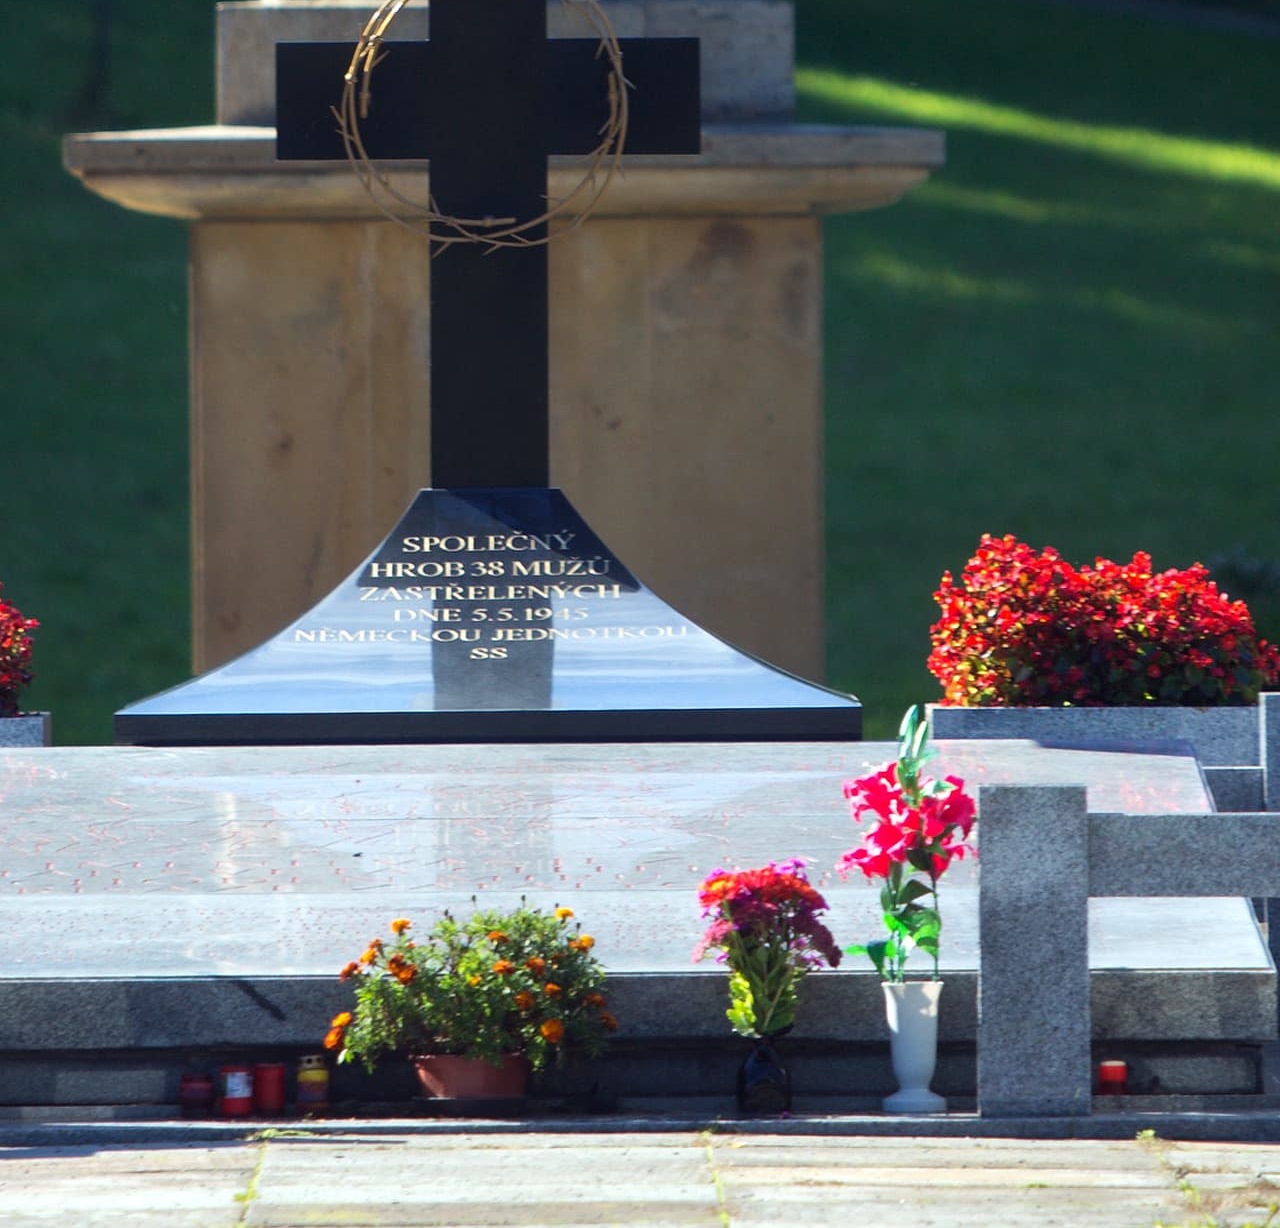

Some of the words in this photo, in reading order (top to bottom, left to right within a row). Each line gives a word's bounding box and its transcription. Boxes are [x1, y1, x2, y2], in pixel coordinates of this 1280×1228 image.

[402, 530, 576, 553] SPOLEČNÝ
[371, 561, 465, 578] HROB
[471, 560, 505, 577] 38
[512, 557, 610, 576] MUŽŮ
[360, 581, 620, 601] ZASTŘELENÝCH
[394, 608, 462, 622] DNE
[295, 627, 481, 643] NĚMECKOU
[491, 626, 687, 641] JEDNOTKOU
[471, 647, 509, 660] SS
